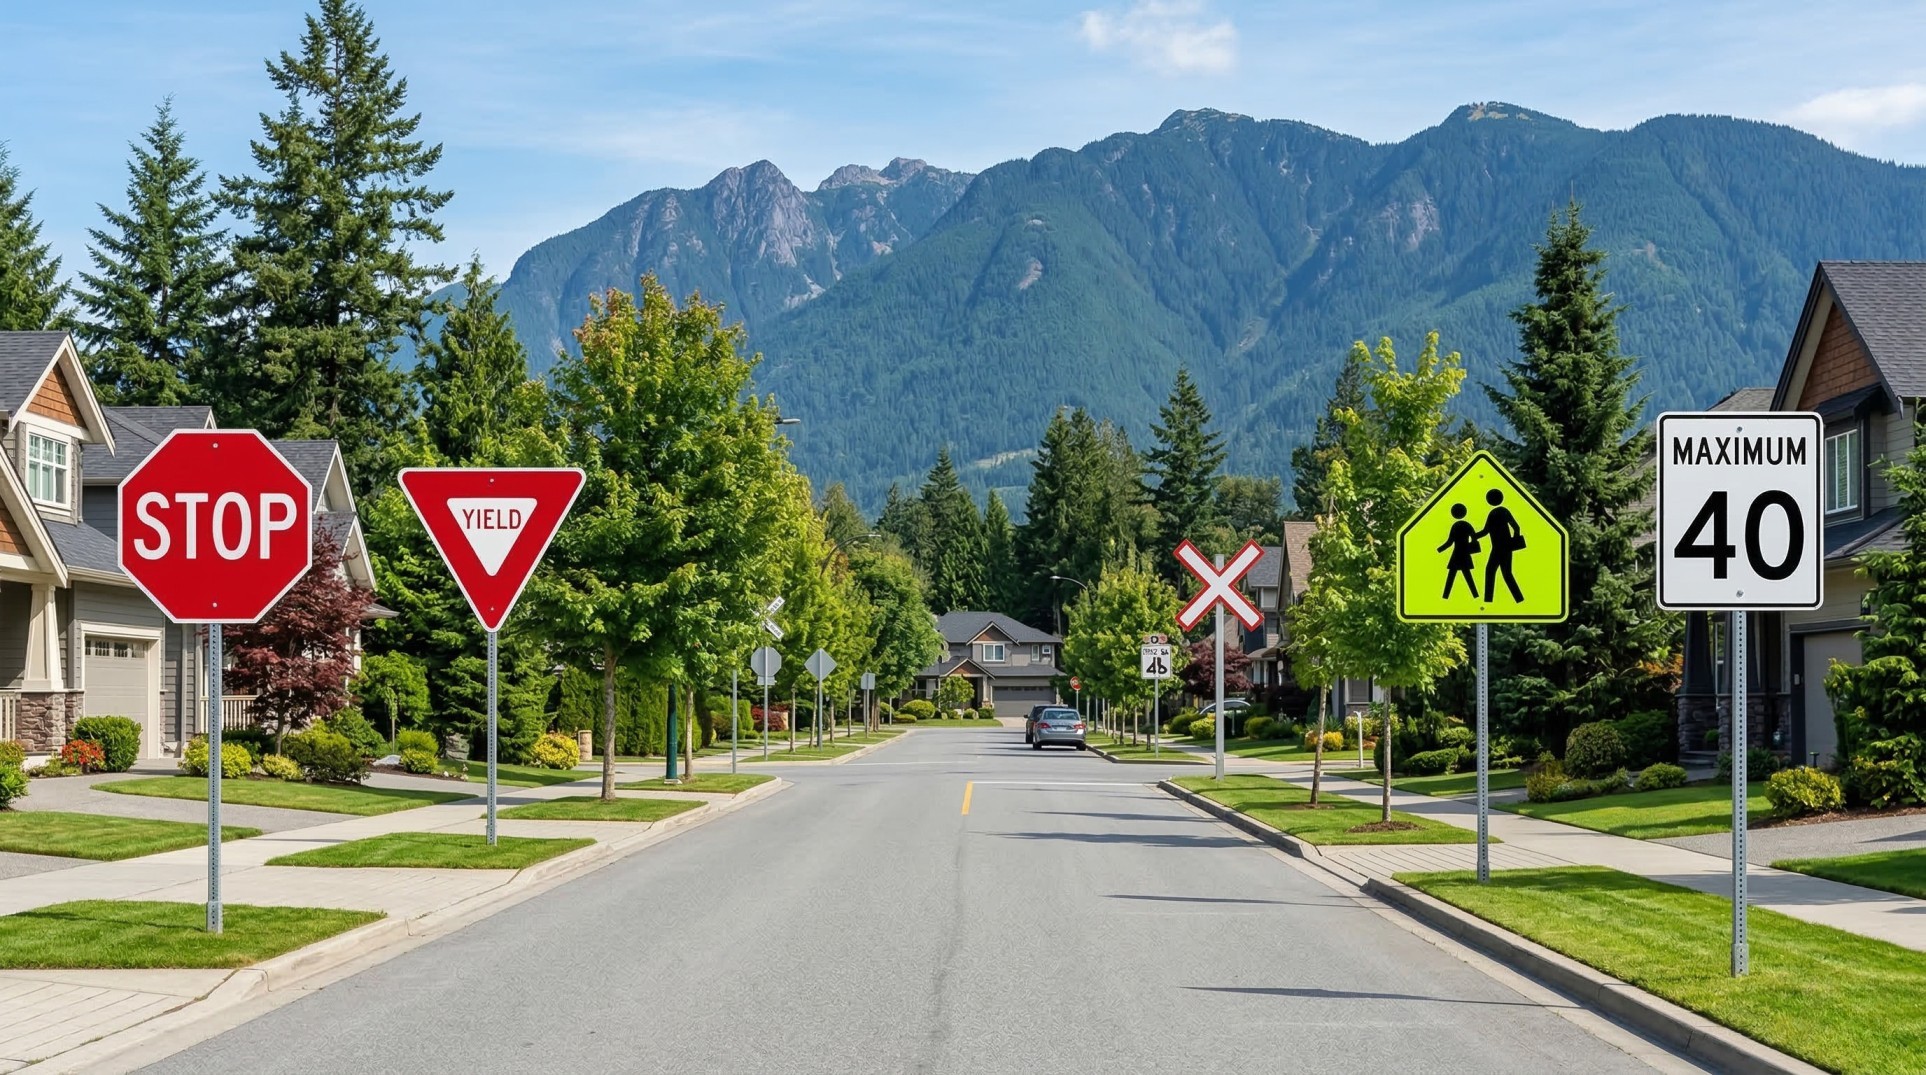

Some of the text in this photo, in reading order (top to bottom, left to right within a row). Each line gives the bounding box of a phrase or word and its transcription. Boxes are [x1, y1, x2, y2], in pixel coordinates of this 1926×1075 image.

[1673, 437, 1806, 466] MAXIMUM
[134, 491, 298, 560] STOP
[462, 508, 522, 530] YIELD
[1674, 489, 1805, 581] 40
